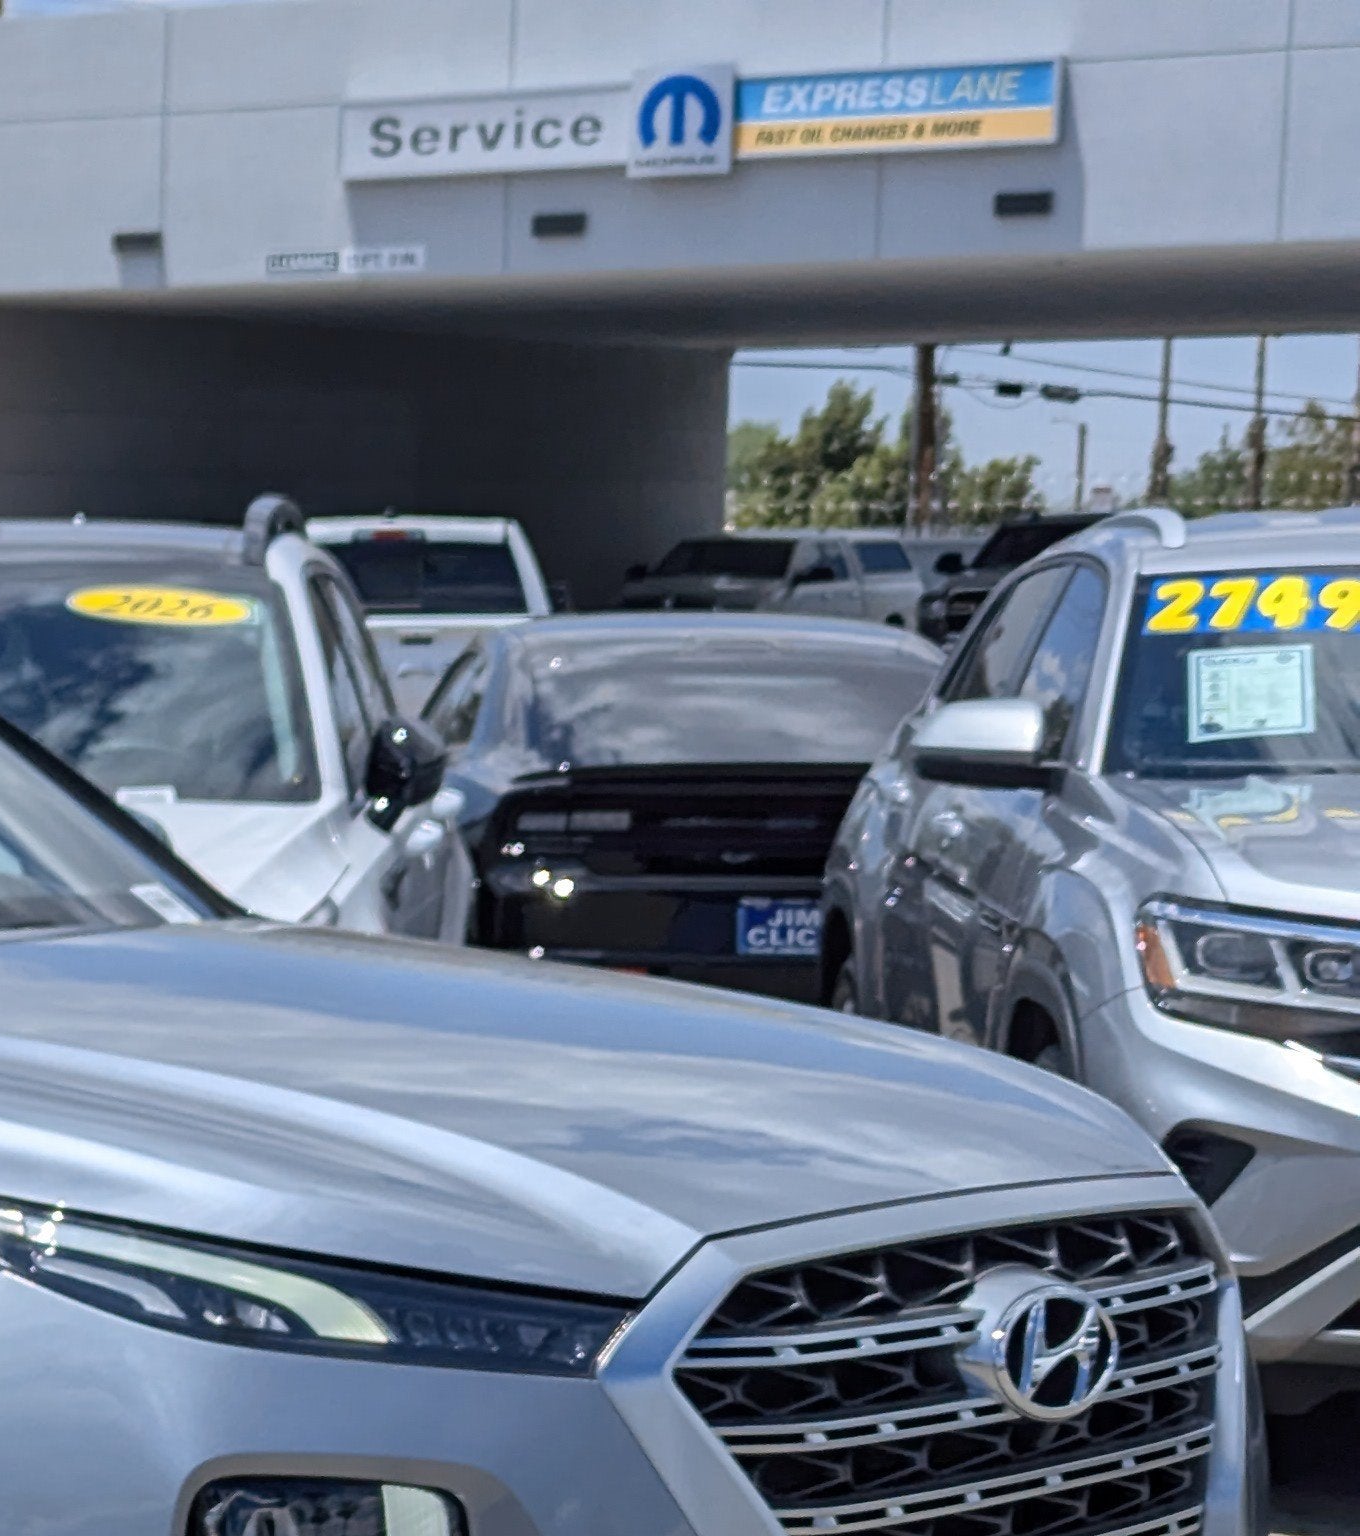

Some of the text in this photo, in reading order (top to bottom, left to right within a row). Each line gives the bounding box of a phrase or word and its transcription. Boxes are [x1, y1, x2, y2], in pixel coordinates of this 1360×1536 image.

[369, 107, 604, 159] Service
[931, 118, 983, 138] MORE
[768, 908, 821, 927] JIM
